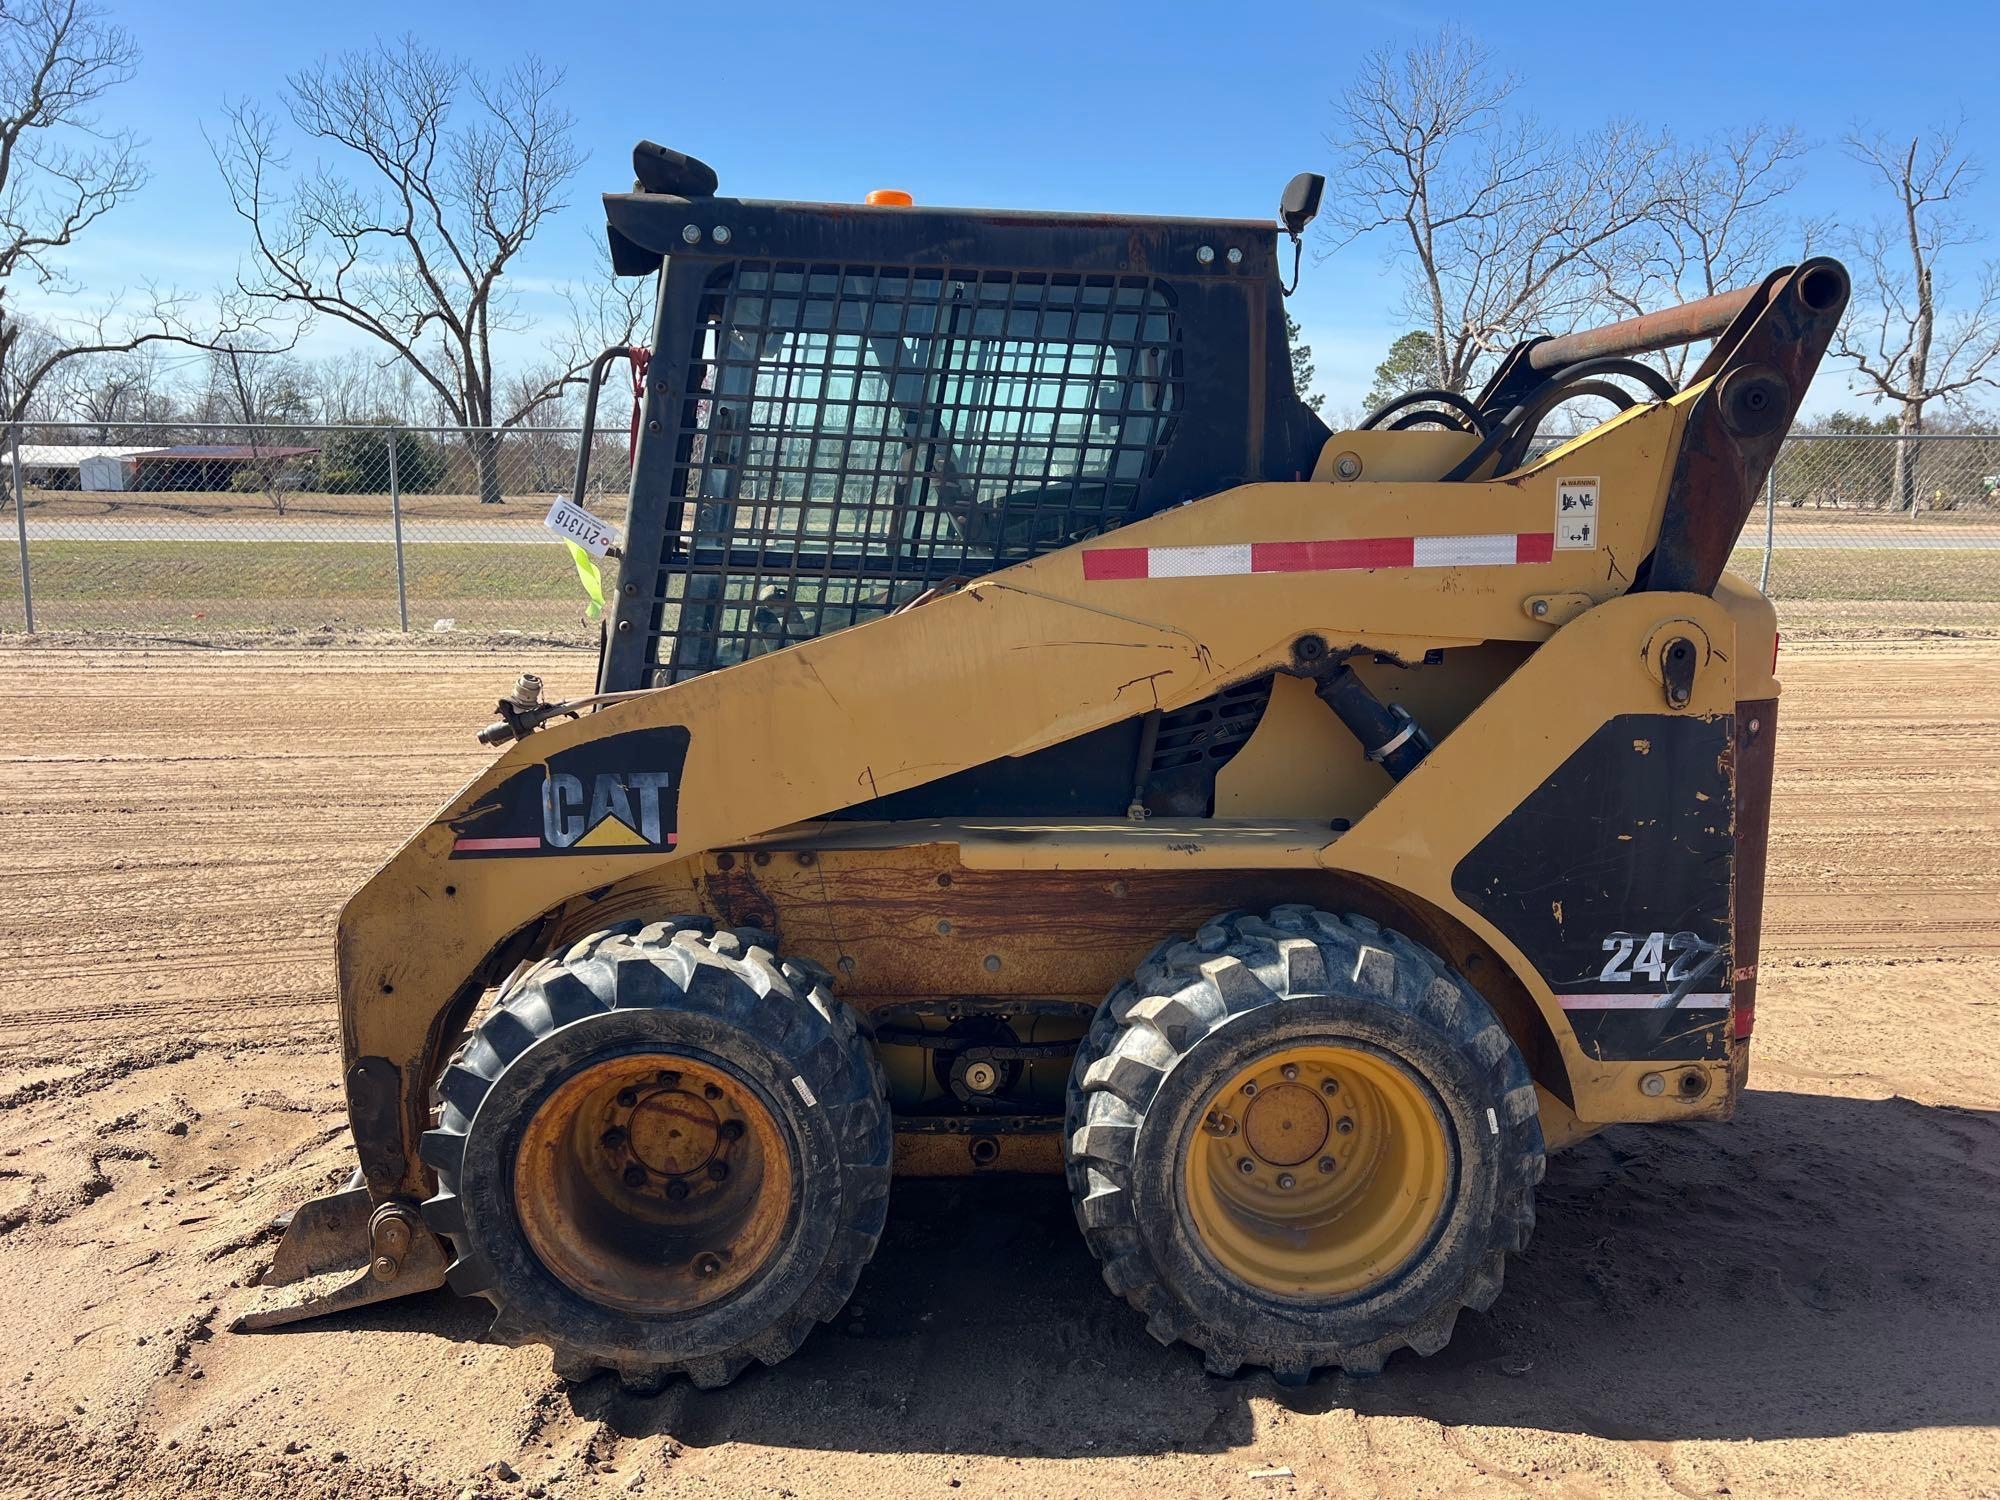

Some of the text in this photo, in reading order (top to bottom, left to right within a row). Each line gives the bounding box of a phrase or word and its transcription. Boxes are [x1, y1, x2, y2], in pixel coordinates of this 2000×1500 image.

[555, 510, 600, 545] 211316
[541, 772, 668, 848] CAT
[1599, 931, 1700, 982] 242
[800, 1120, 817, 1148] DUTY
